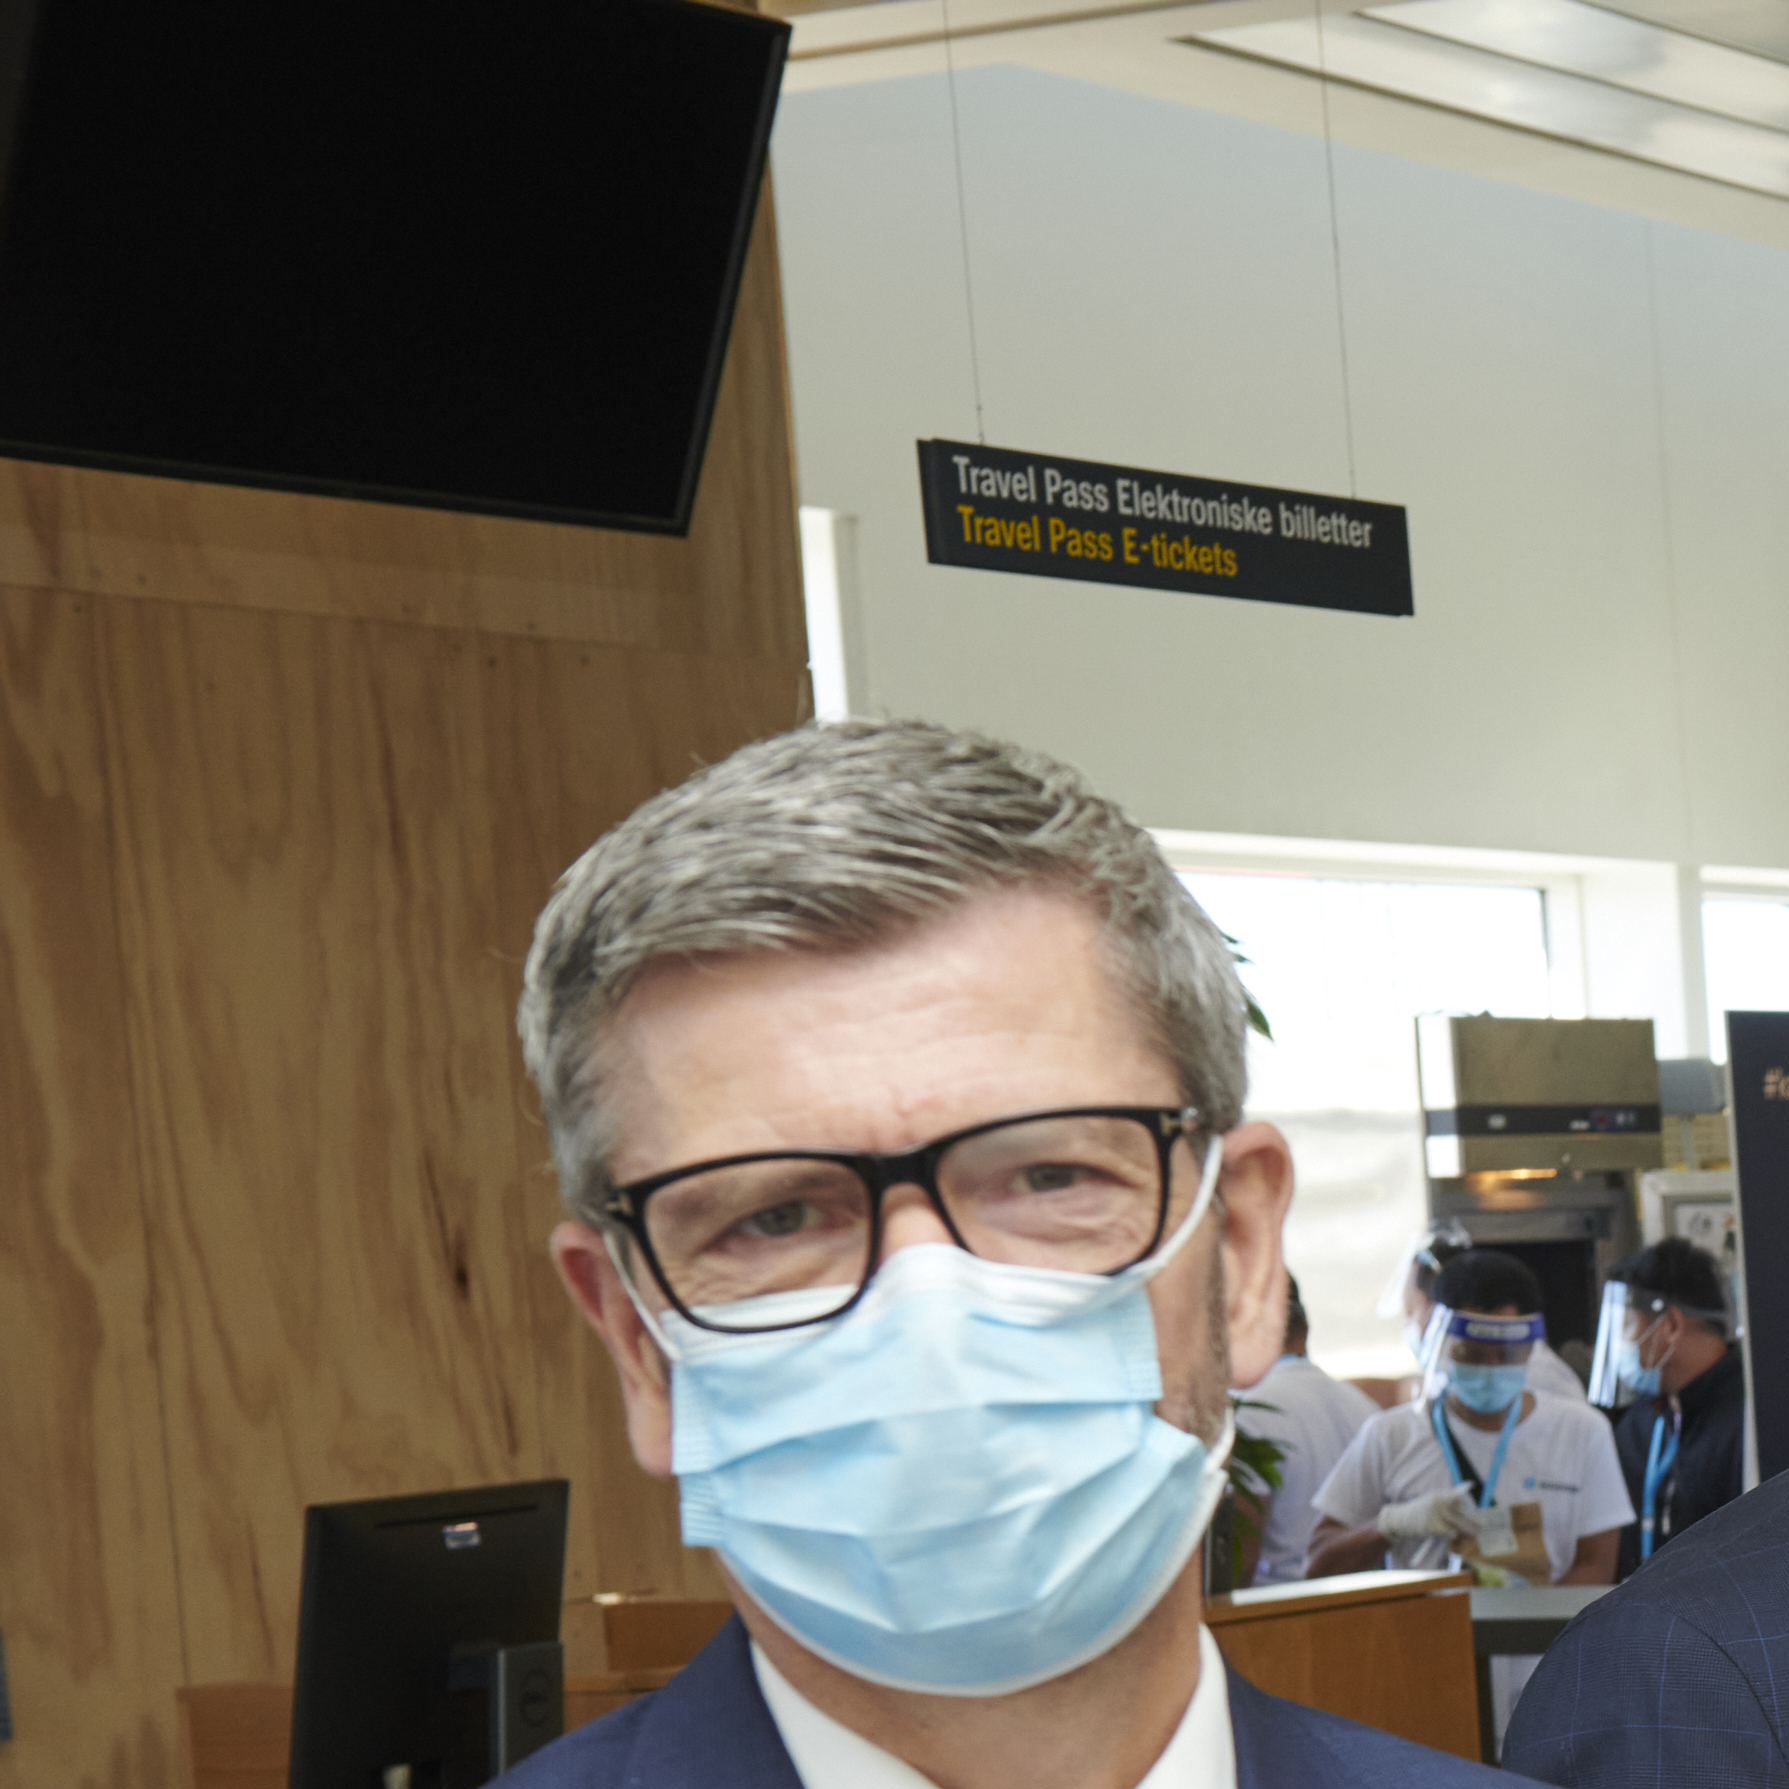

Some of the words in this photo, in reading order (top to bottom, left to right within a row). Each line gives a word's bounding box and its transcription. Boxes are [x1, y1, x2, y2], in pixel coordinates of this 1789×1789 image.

[952, 455, 1036, 503] Travel
[1044, 467, 1110, 514] Pass
[1117, 478, 1272, 536] Elektroniske
[1280, 502, 1372, 549] billetter
[957, 505, 1041, 552] Travel
[1049, 517, 1113, 562] Pass
[1123, 527, 1238, 577] E-tickets
